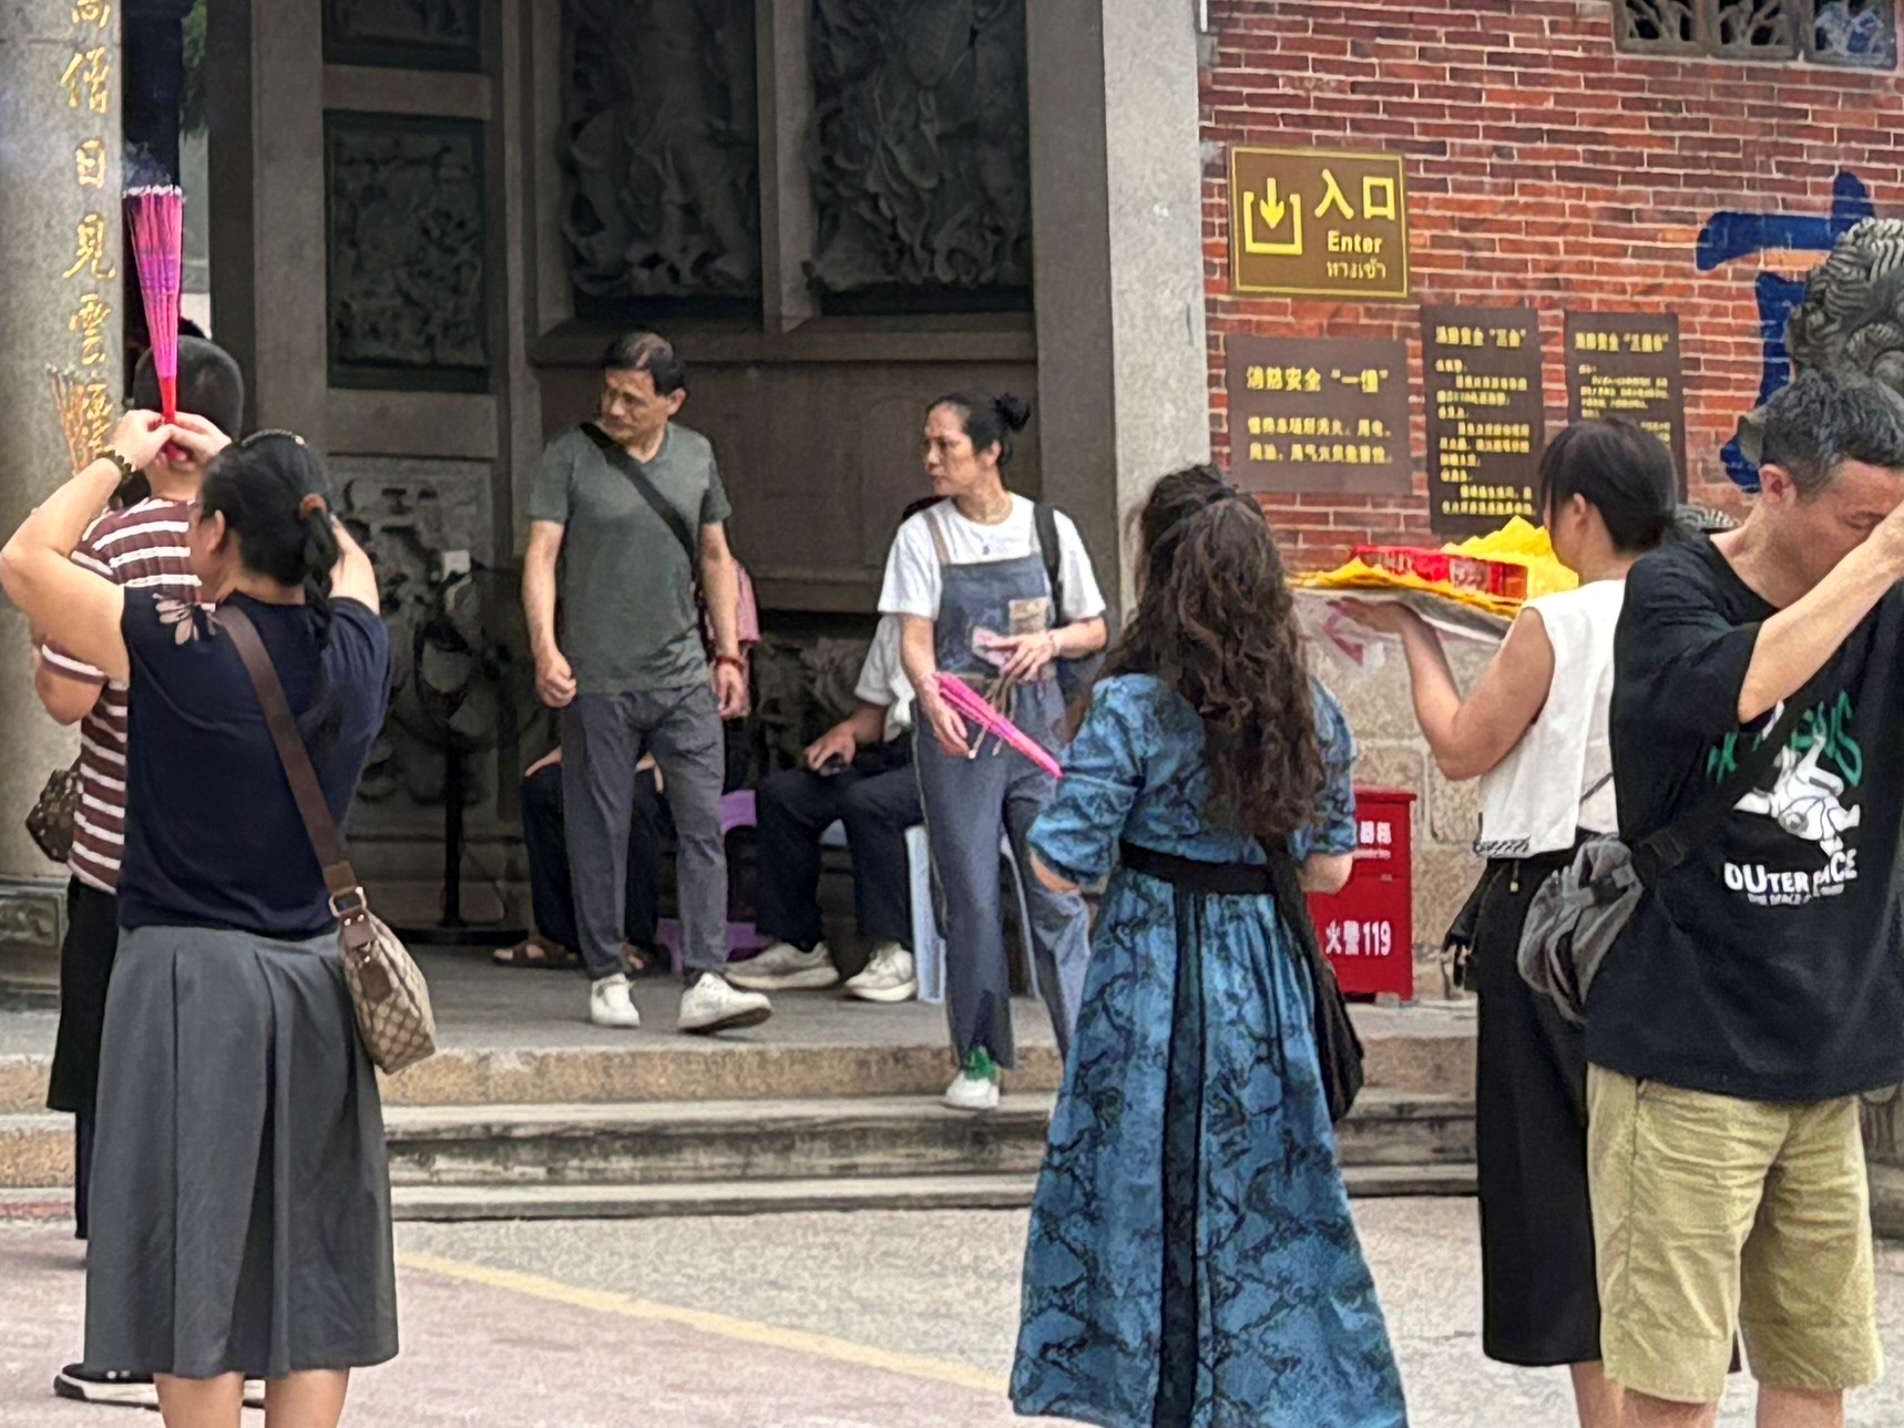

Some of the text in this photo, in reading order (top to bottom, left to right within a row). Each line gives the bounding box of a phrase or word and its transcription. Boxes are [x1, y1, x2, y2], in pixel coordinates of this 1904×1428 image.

[1314, 169, 1396, 220] 入口
[1327, 230, 1383, 253] Enter
[1724, 861, 1810, 894] OUTER
